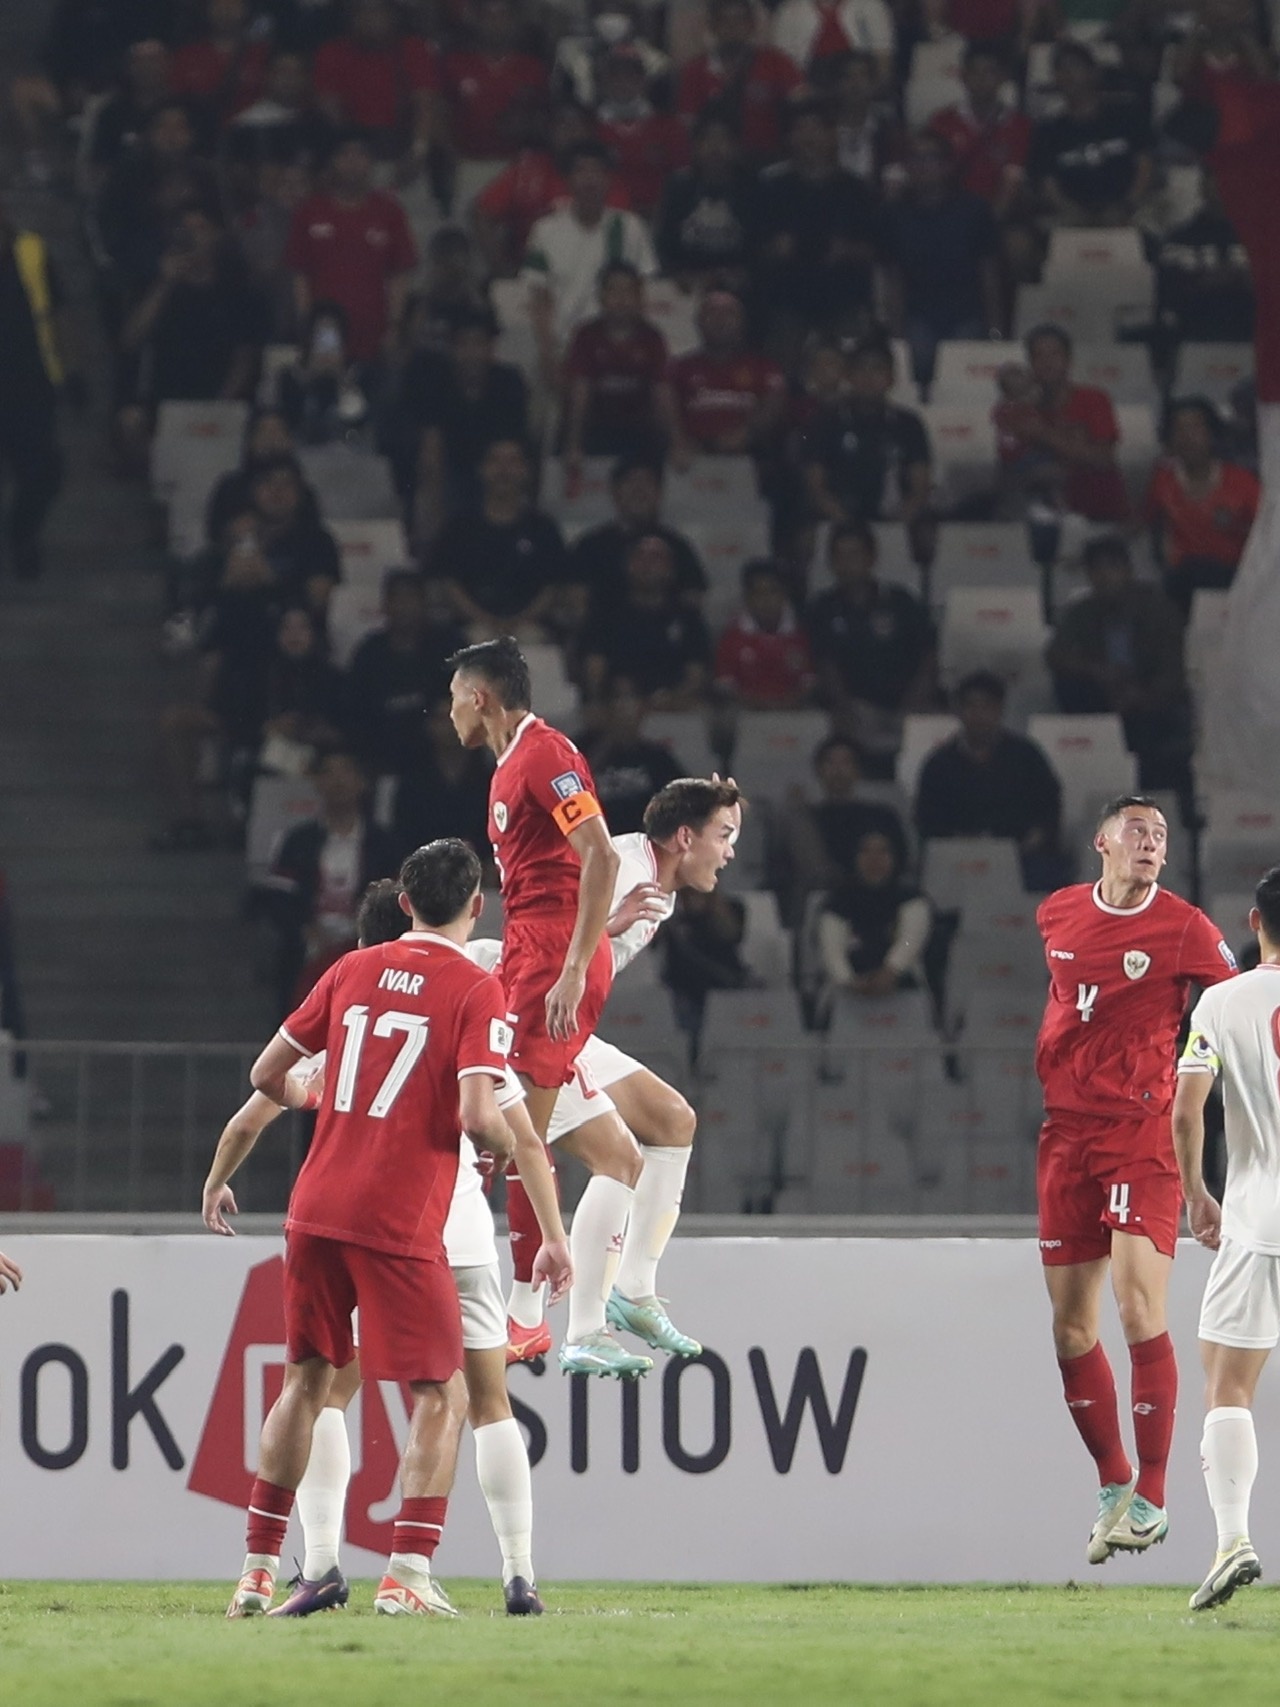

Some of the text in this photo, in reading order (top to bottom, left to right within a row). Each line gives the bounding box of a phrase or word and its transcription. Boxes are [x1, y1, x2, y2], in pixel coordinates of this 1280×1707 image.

[561, 800, 582, 824] C
[377, 967, 425, 996] IVAR
[1075, 983, 1099, 1022] 4
[334, 1004, 430, 1118] 17
[1109, 1183, 1131, 1224] 4
[1040, 1239, 1062, 1250] rspo
